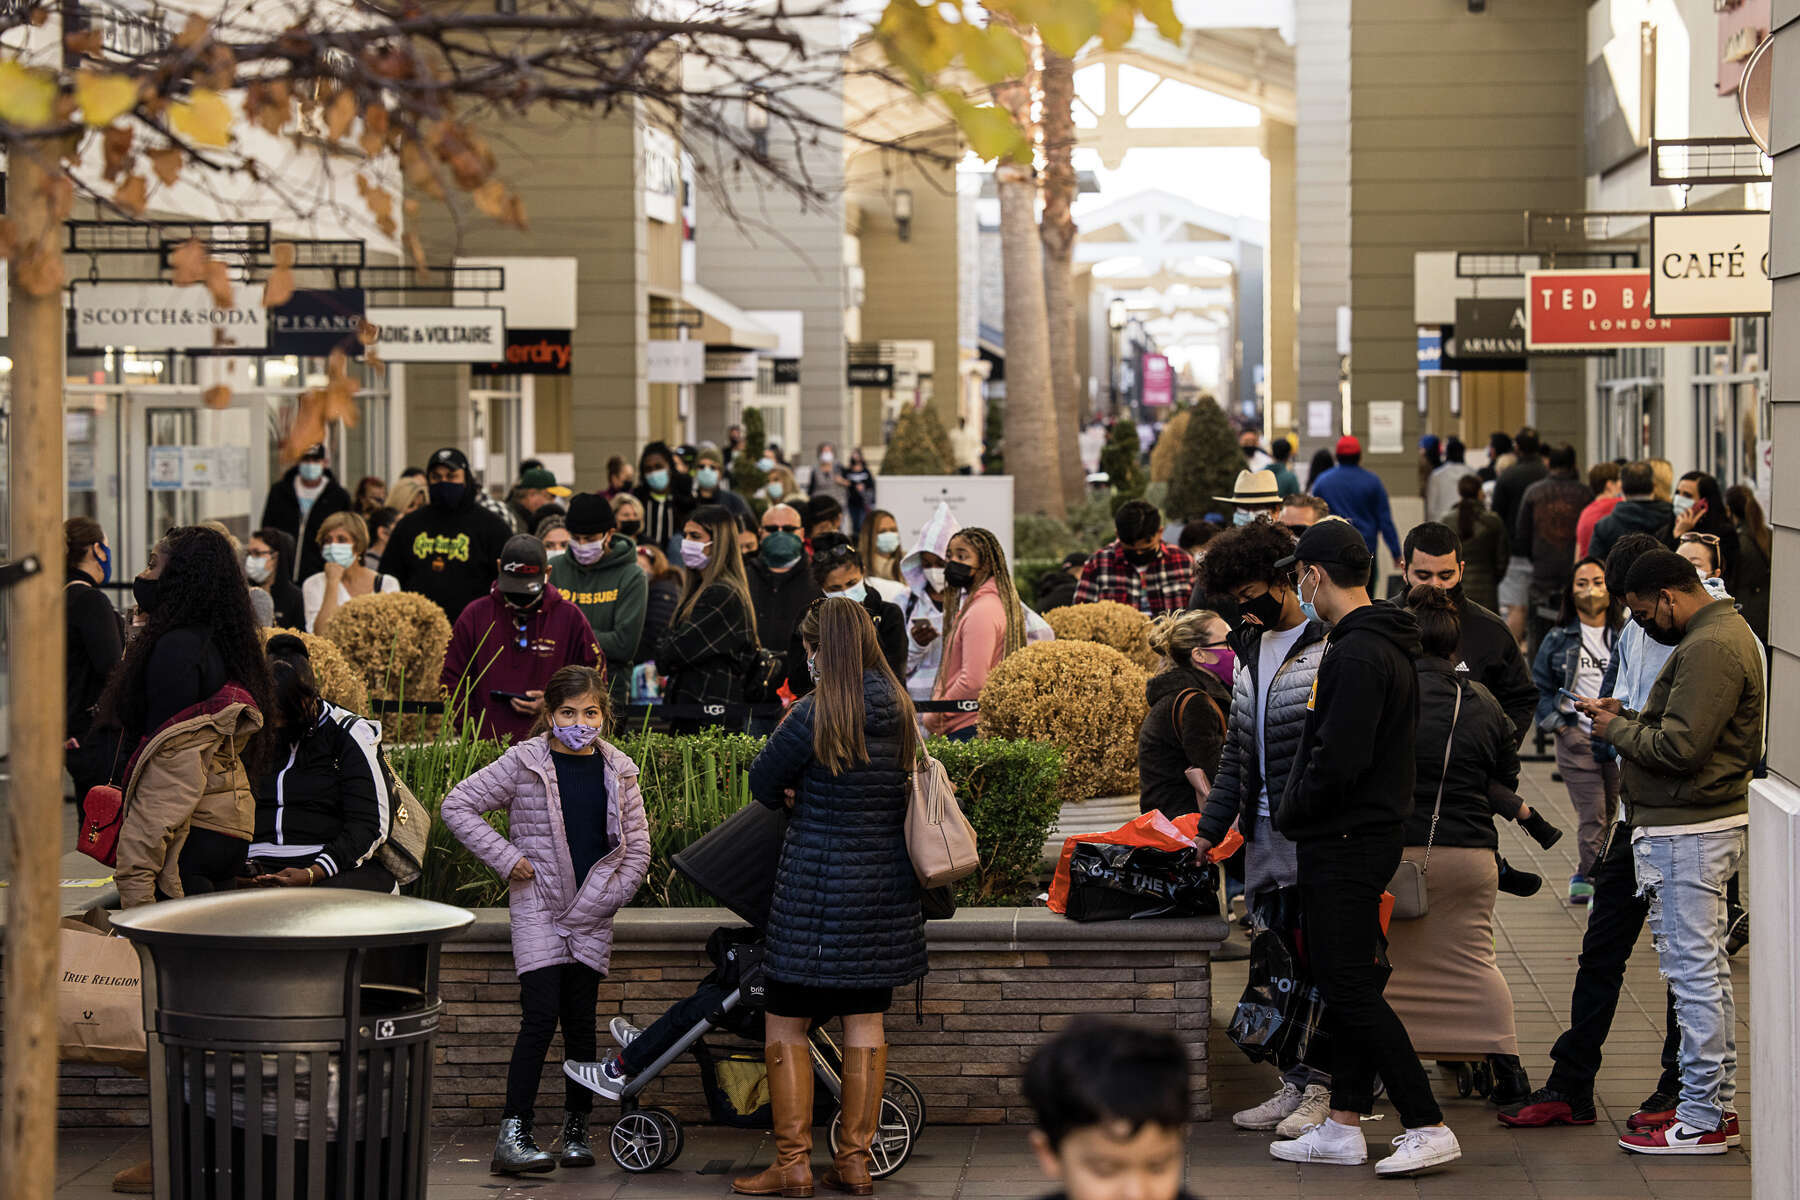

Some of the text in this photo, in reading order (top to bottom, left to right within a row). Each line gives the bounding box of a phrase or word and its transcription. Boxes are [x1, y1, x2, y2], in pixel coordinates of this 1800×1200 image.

[1662, 243, 1745, 279] CAFÉ
[1541, 288, 1598, 311] TED
[82, 307, 259, 326] SCOTCH&SODA
[1589, 318, 1672, 331] LONDON
[376, 325, 410, 343] ADIG
[425, 325, 493, 343] VOLTAIRE
[1463, 337, 1523, 354] ARMANI
[703, 704, 726, 716] UGG
[957, 700, 978, 711] UGG
[1129, 871, 1165, 893] THE
[62, 970, 140, 987] TRUE RELIGION
